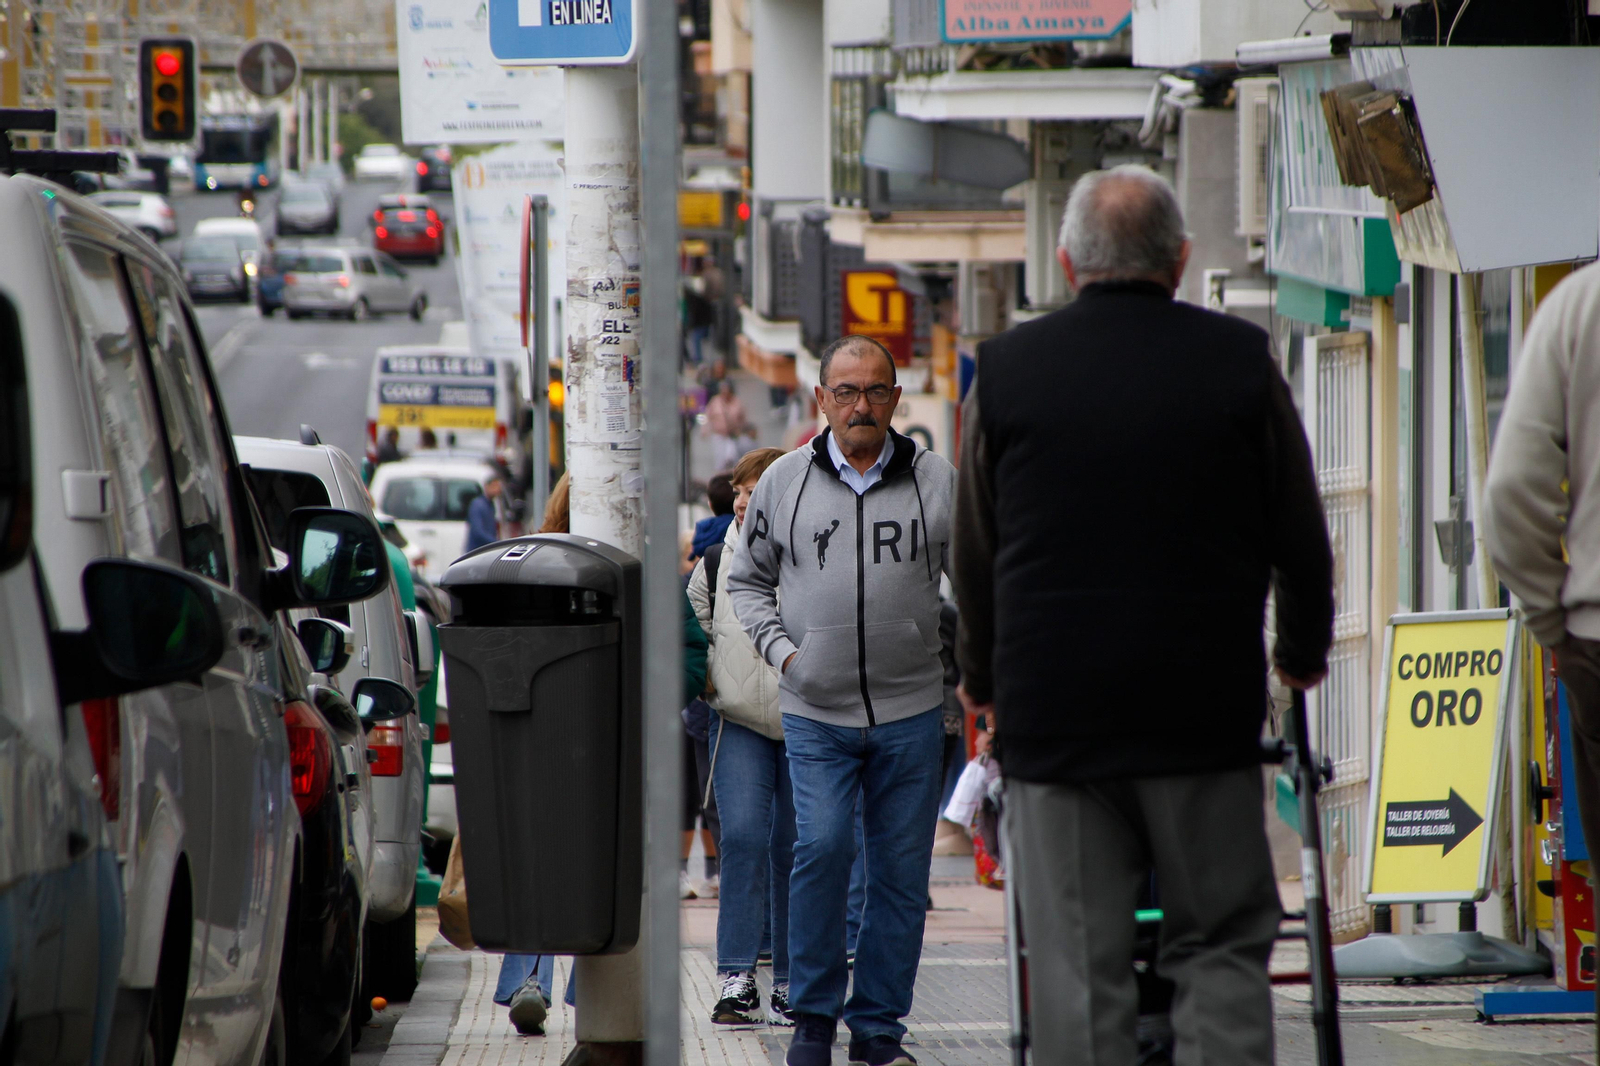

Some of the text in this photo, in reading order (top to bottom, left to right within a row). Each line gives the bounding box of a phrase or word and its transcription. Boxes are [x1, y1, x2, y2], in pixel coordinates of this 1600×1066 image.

[552, 1, 570, 25] EN
[953, 15, 1105, 33] Alba Amaya
[873, 518, 918, 564] RI
[1398, 648, 1503, 680] COMPRO
[1410, 688, 1483, 728] ORO
[1387, 806, 1450, 822] TALLER DE JOYERÍA
[1386, 822, 1456, 837] TALLER DE RELOJERÍA
